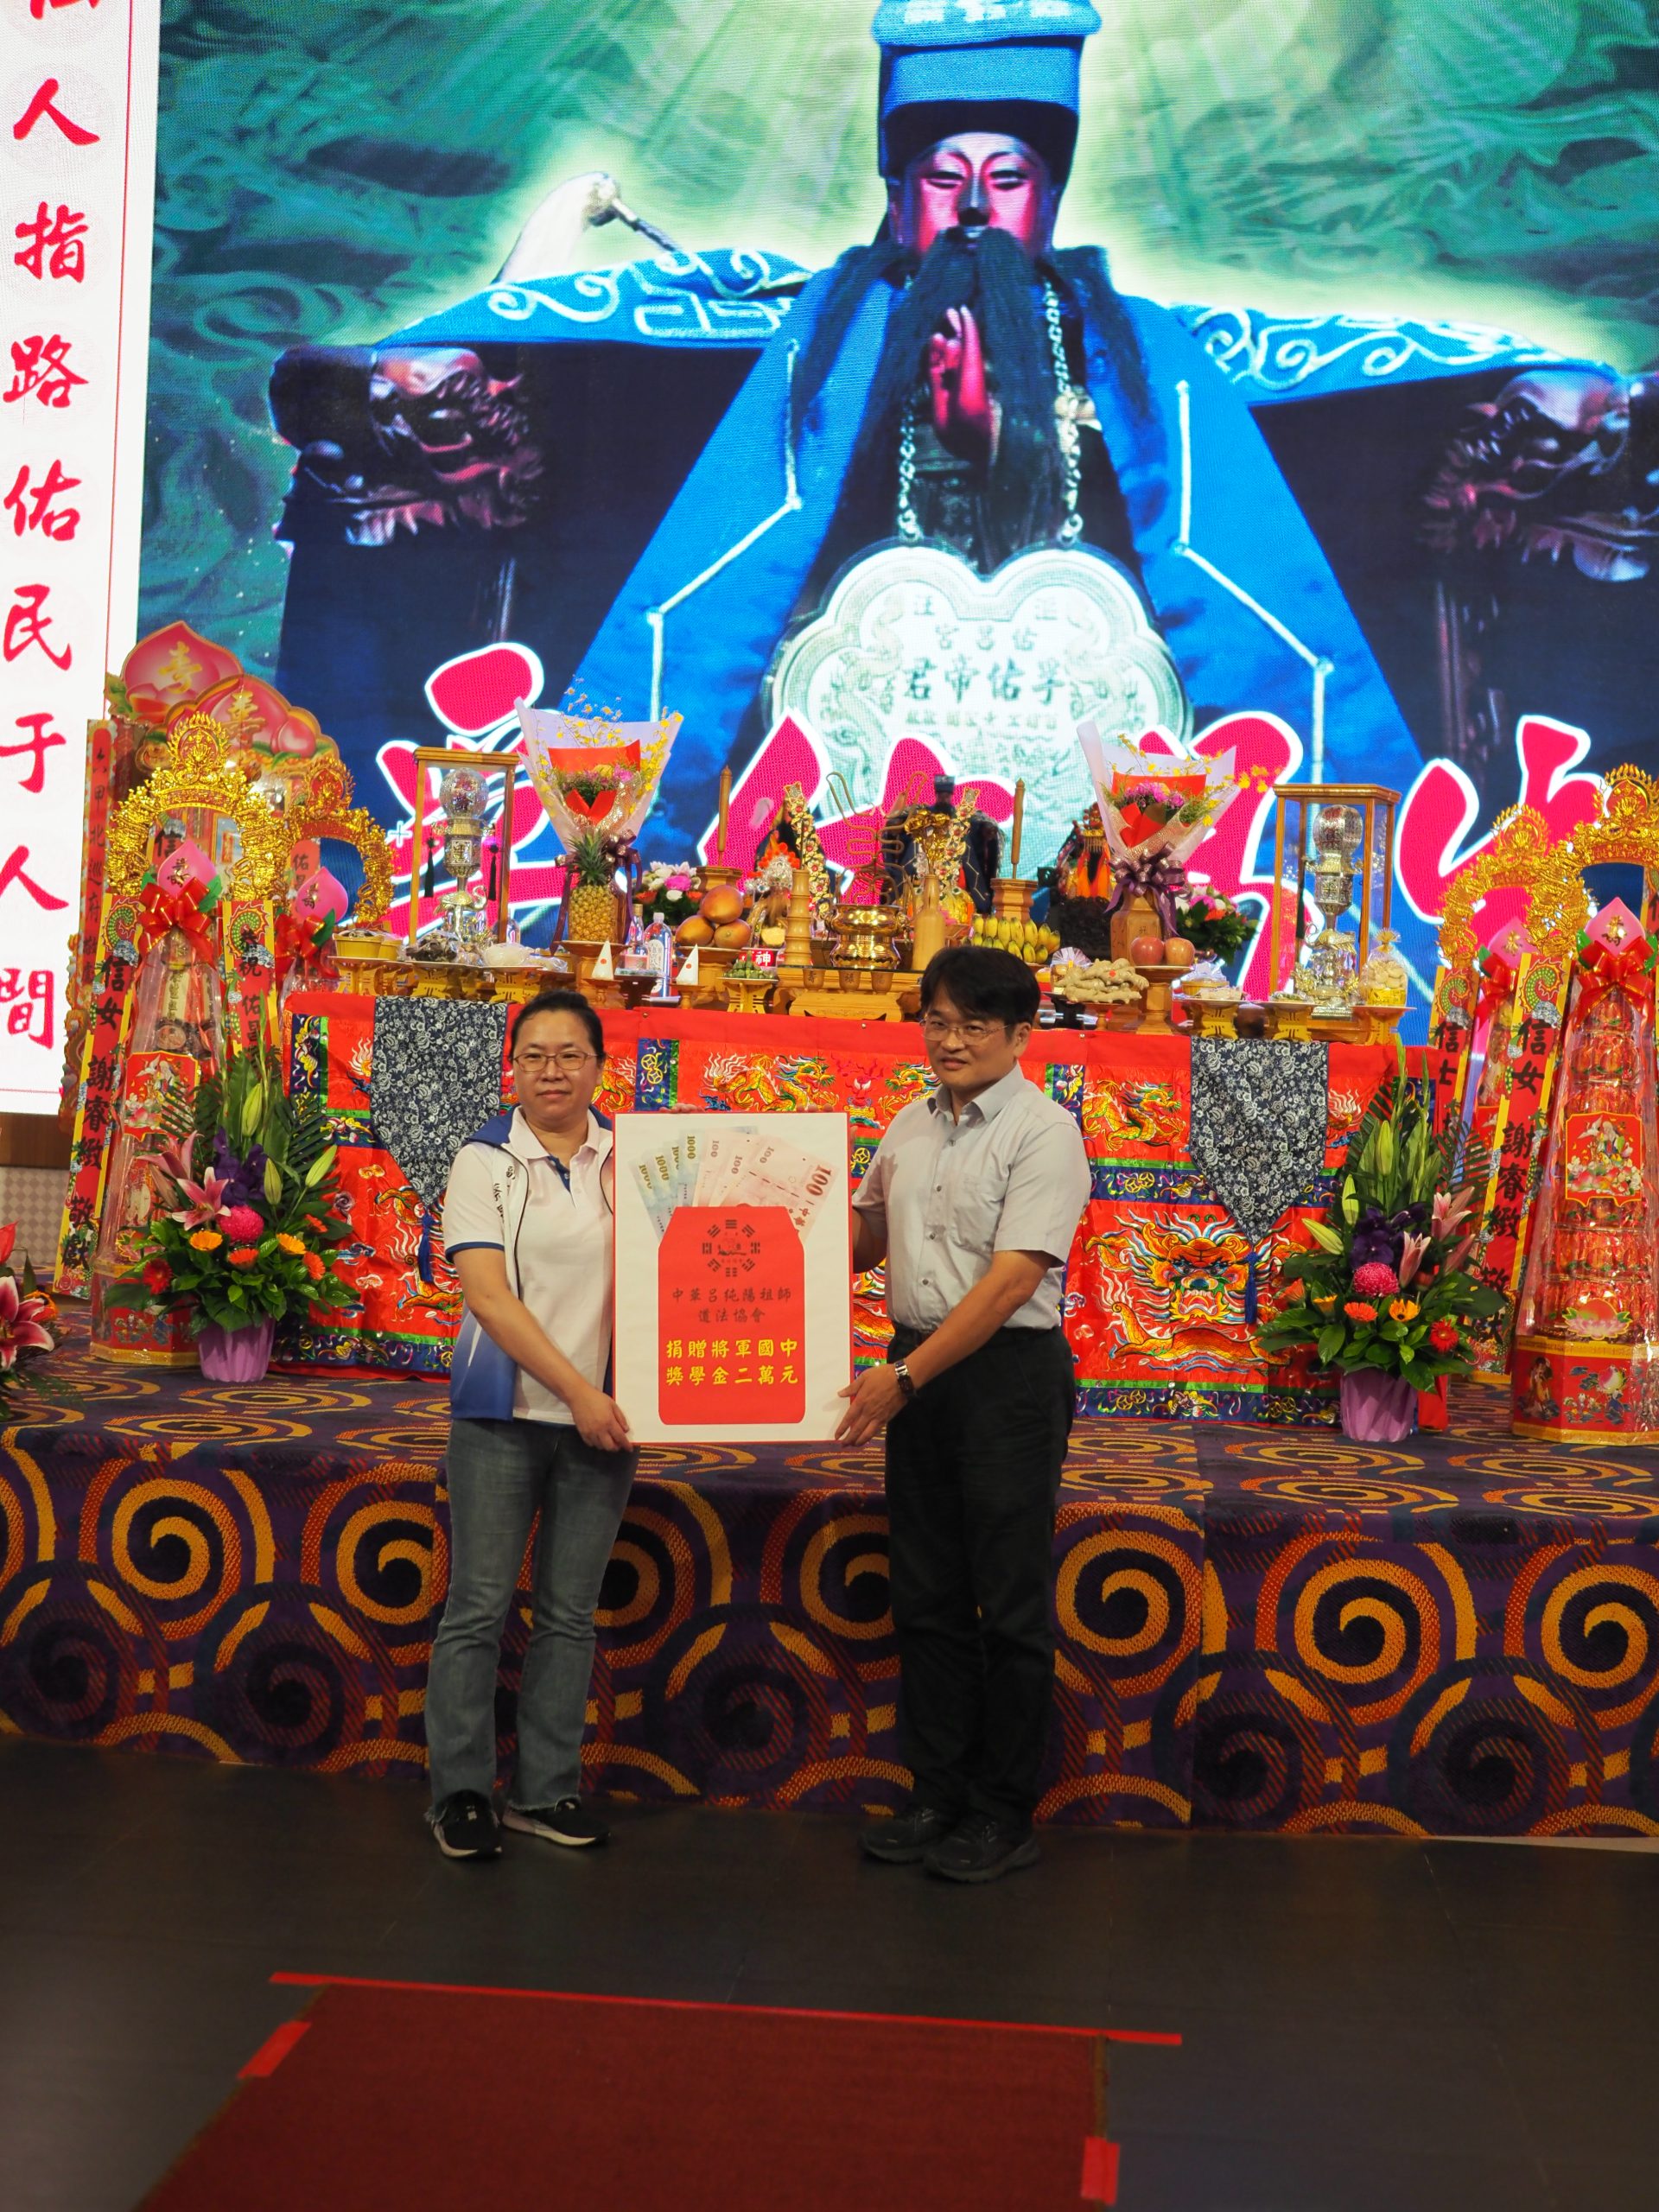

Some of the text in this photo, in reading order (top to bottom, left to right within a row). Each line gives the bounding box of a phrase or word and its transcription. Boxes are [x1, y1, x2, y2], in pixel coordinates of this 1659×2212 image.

[0, 0, 100, 1049] 人指路佑民于人間
[687, 1135, 696, 1160] 1000
[710, 1140, 720, 1158] 100
[760, 1147, 775, 1164] 100
[655, 1155, 670, 1180] 1000
[731, 1155, 743, 1174] 100
[805, 1165, 832, 1197] 100
[698, 1306, 766, 1324] 道法協會
[666, 1338, 798, 1359] 捐贈將軍國中
[666, 1365, 798, 1387] 獎學金二萬元
